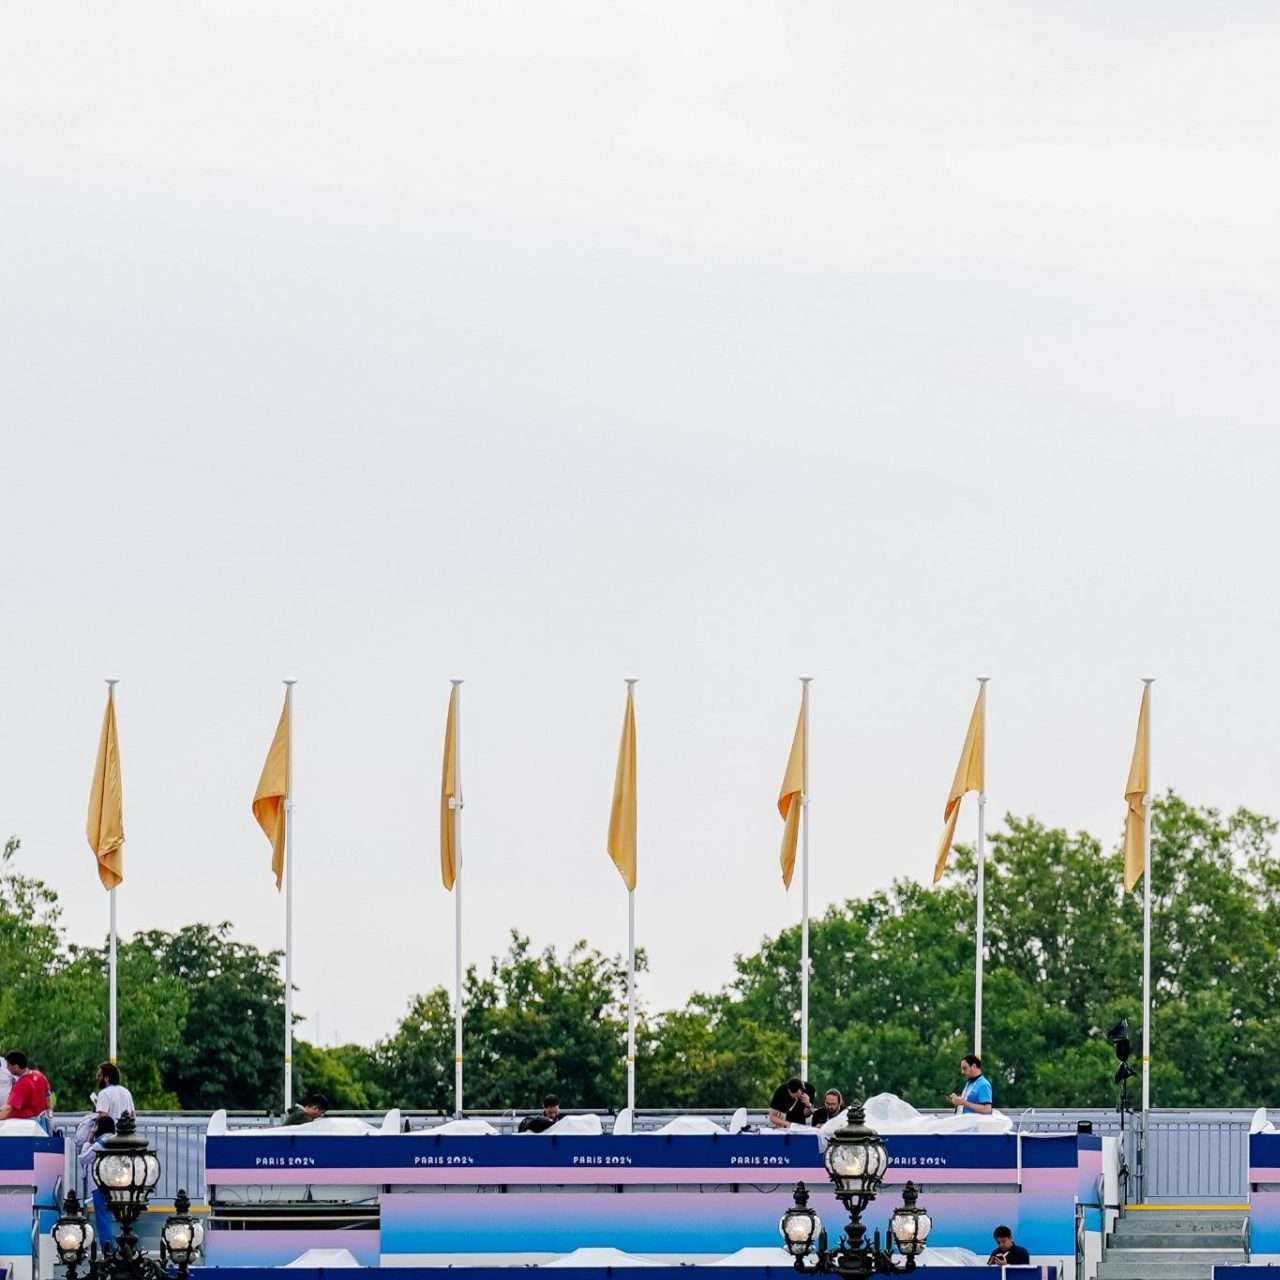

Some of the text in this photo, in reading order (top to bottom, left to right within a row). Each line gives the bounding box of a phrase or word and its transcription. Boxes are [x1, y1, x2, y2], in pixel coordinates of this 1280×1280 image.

[288, 1157, 315, 1166] 2024
[447, 1156, 474, 1166] 2024
[606, 1156, 633, 1165] 2024
[763, 1156, 790, 1165] 2024
[920, 1156, 947, 1165] 2024
